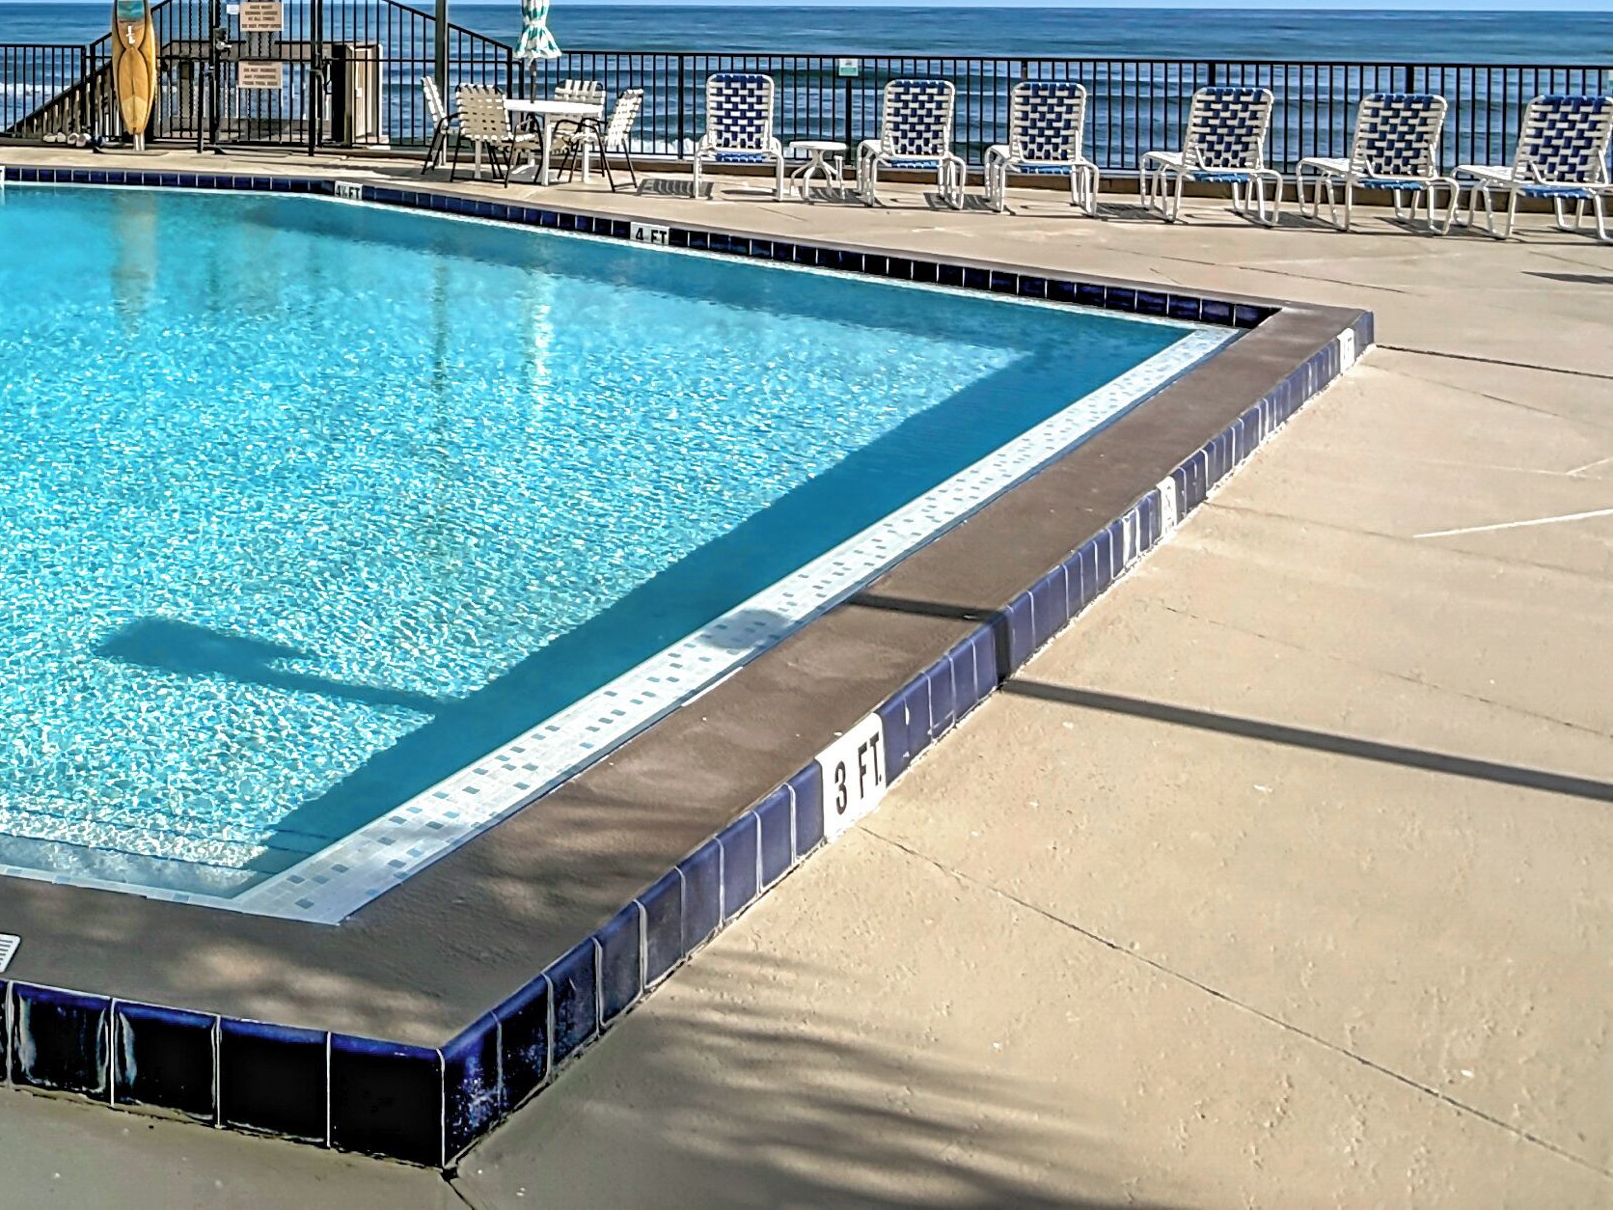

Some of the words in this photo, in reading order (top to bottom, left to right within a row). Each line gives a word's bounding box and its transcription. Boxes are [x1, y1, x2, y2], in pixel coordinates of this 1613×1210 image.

[635, 227, 644, 241] 4
[650, 230, 668, 245] FT
[834, 760, 848, 815] 3
